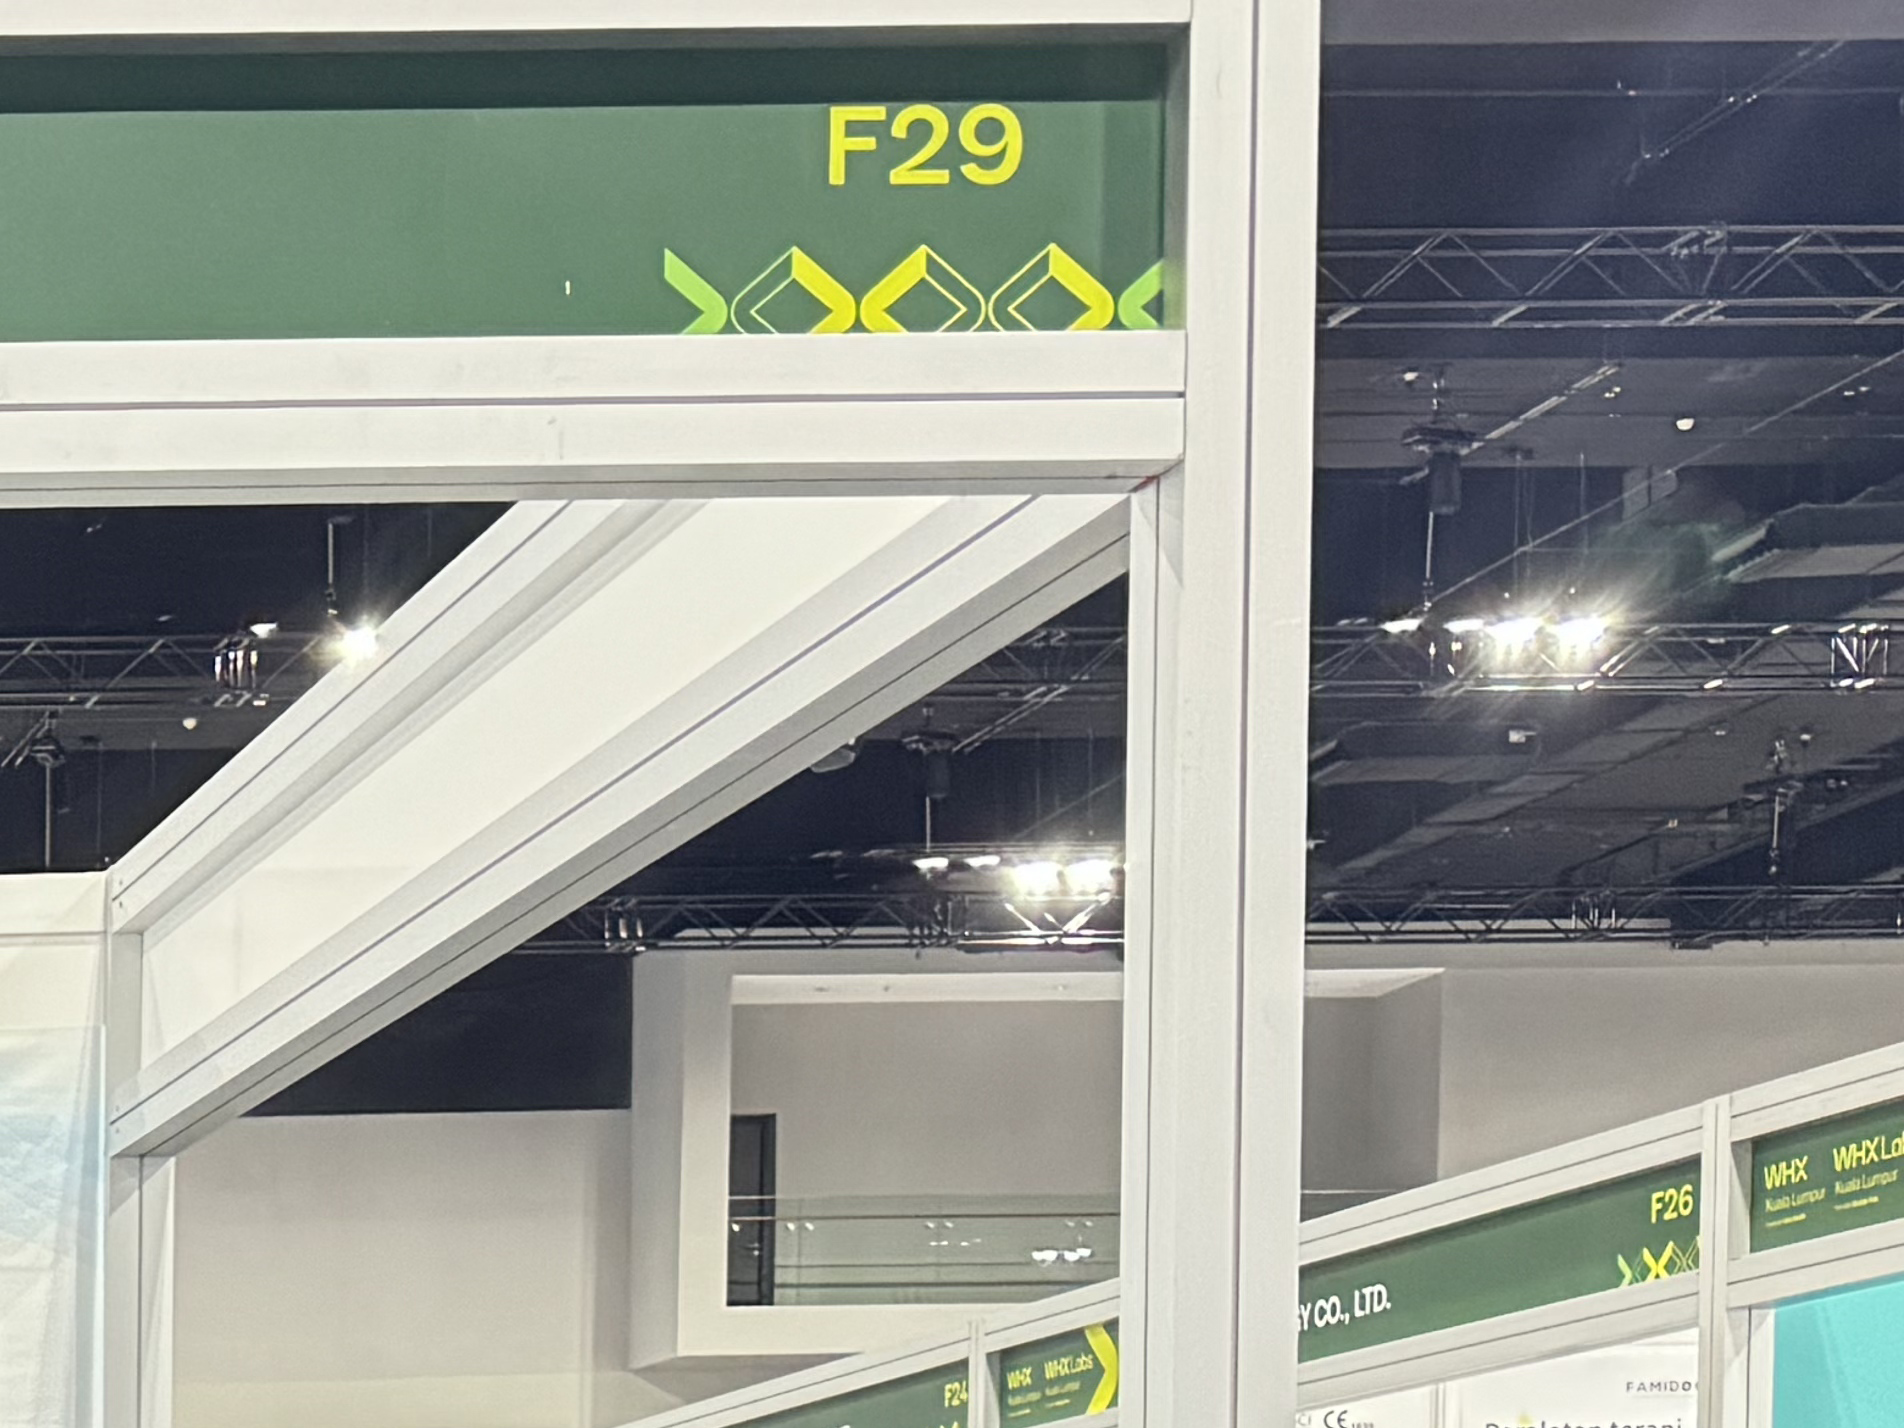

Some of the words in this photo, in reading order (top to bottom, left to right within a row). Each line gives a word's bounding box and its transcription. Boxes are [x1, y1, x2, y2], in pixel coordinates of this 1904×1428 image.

[828, 103, 1023, 186] F29
[1764, 1155, 1808, 1190] WHX
[1833, 1136, 1880, 1172] WHX
[1649, 1183, 1694, 1224] F26
[1314, 1295, 1350, 1328] CO.,
[1354, 1284, 1391, 1318] LTD.
[1626, 1380, 1699, 1393] FAMIDO
